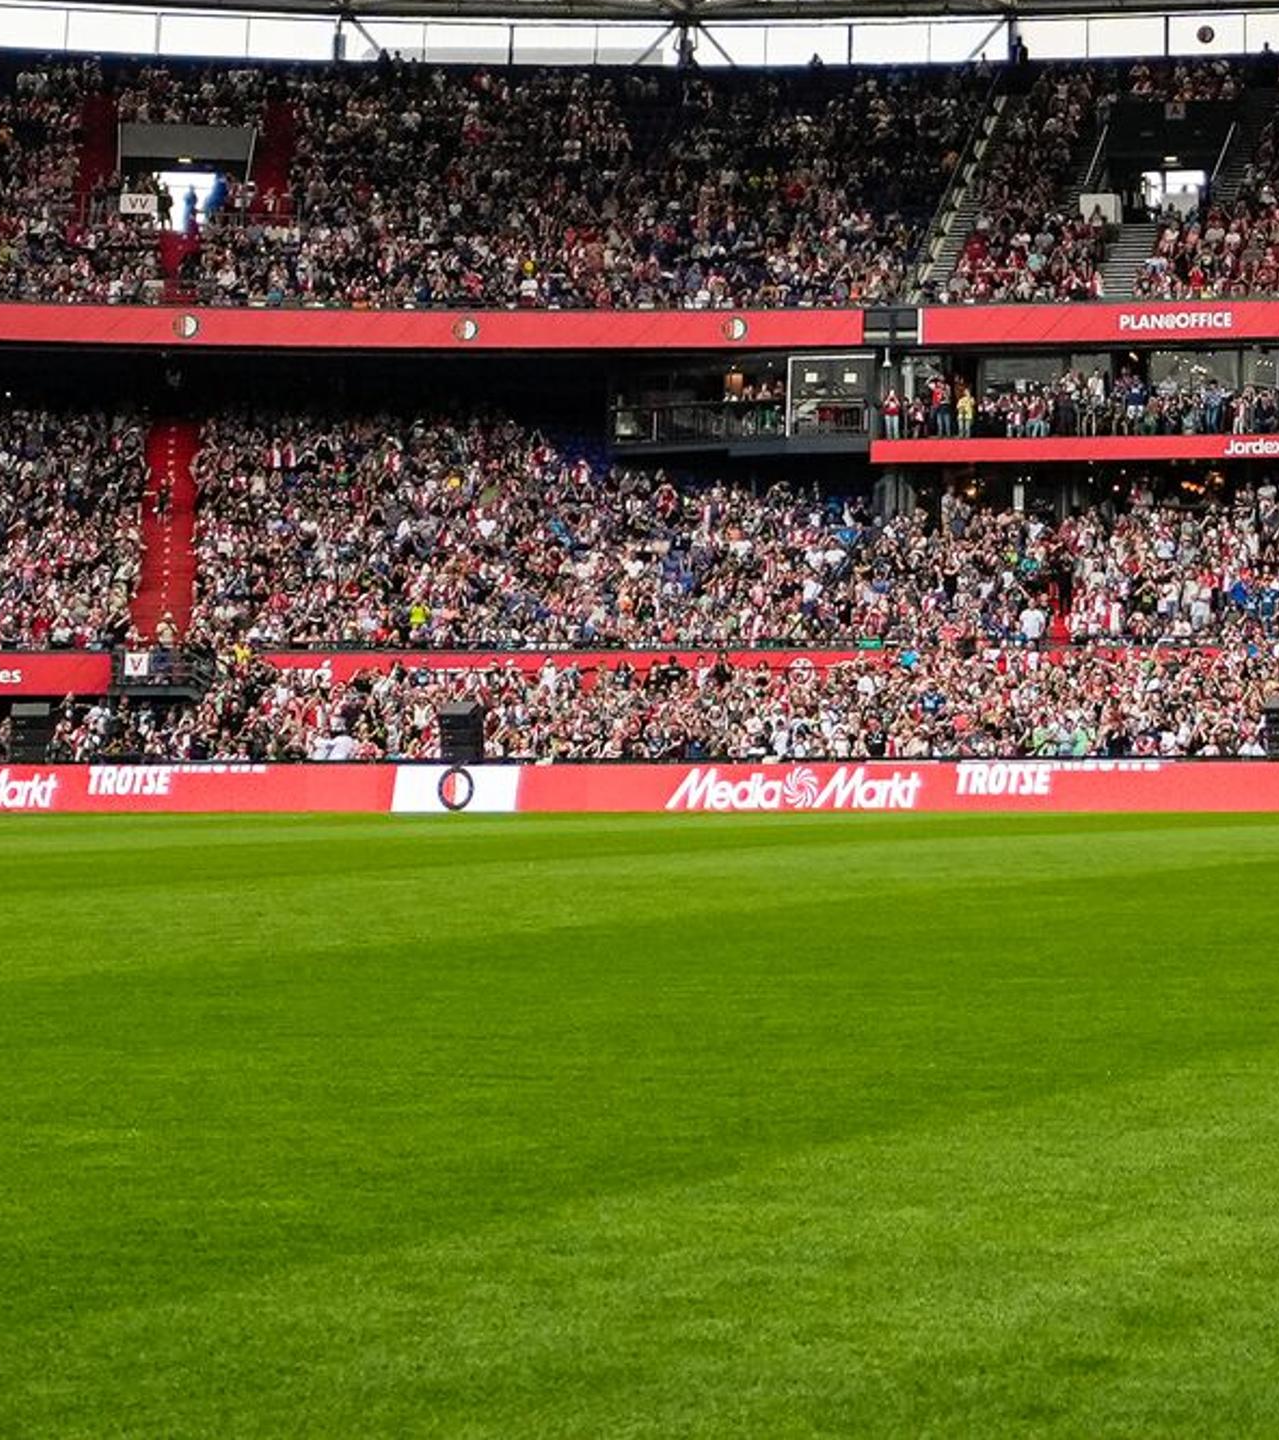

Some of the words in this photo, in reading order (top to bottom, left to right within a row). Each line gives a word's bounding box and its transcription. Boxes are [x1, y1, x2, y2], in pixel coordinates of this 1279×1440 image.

[88, 766, 172, 795] TROTSE
[665, 767, 782, 810] Media
[814, 767, 922, 809] Markt
[956, 764, 1051, 795] TROTSE
